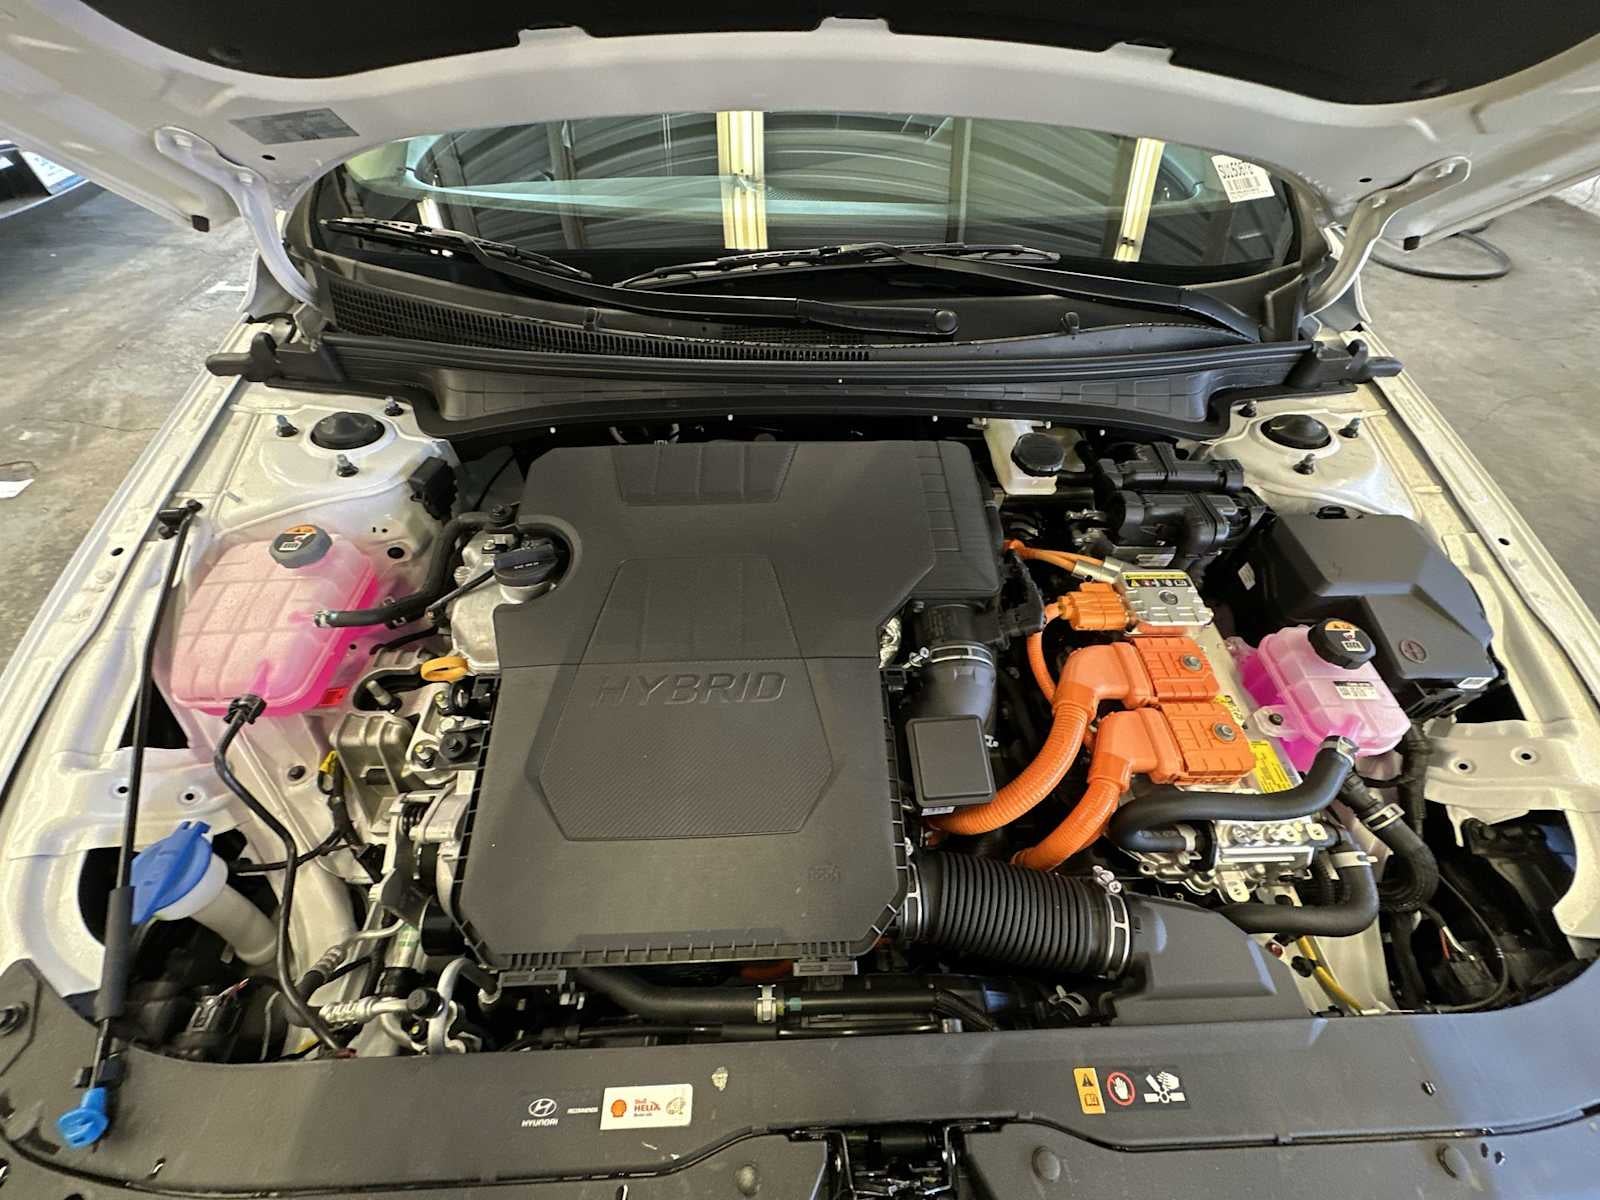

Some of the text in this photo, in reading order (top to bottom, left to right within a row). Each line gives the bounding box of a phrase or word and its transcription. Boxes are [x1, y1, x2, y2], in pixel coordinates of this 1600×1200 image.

[591, 672, 787, 705] HYBRID
[633, 1102, 661, 1113] HELIX
[521, 1118, 559, 1128] HYUNDAI
